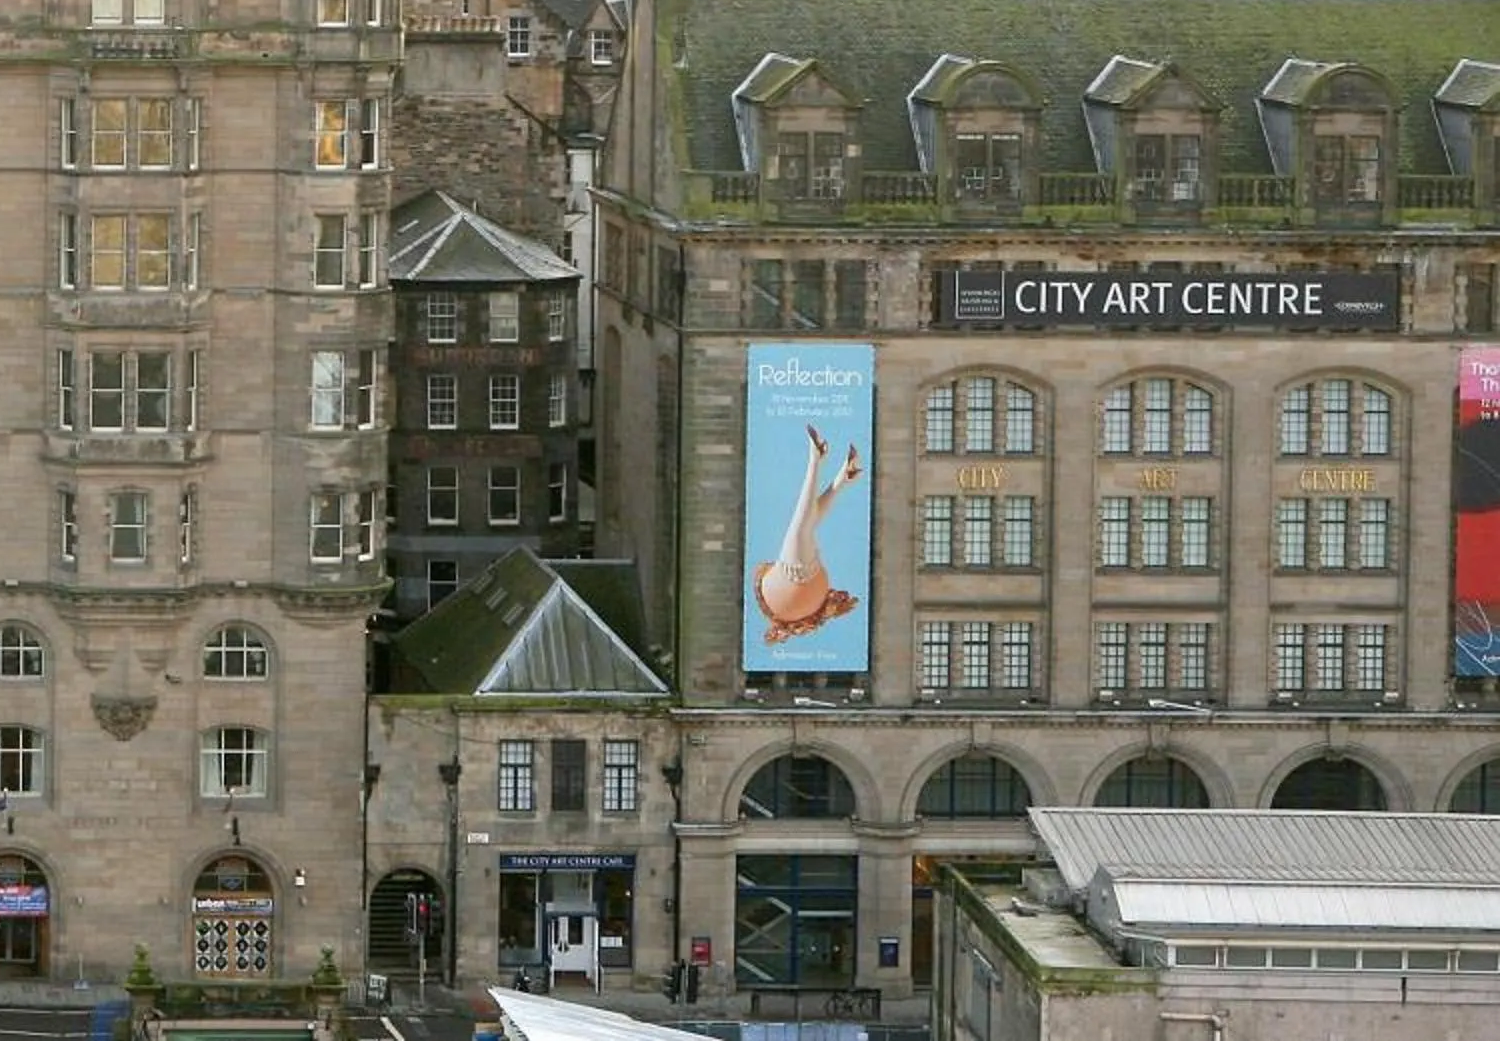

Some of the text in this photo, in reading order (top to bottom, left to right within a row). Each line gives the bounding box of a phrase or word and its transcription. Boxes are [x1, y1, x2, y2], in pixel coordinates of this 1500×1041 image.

[1014, 280, 1324, 315] CITY ART CENTRE
[758, 357, 864, 387] Reflection
[957, 466, 1003, 489] CITY
[1139, 467, 1179, 490] ART
[1300, 469, 1377, 492] CENTRE
[529, 856, 549, 865] CITY
